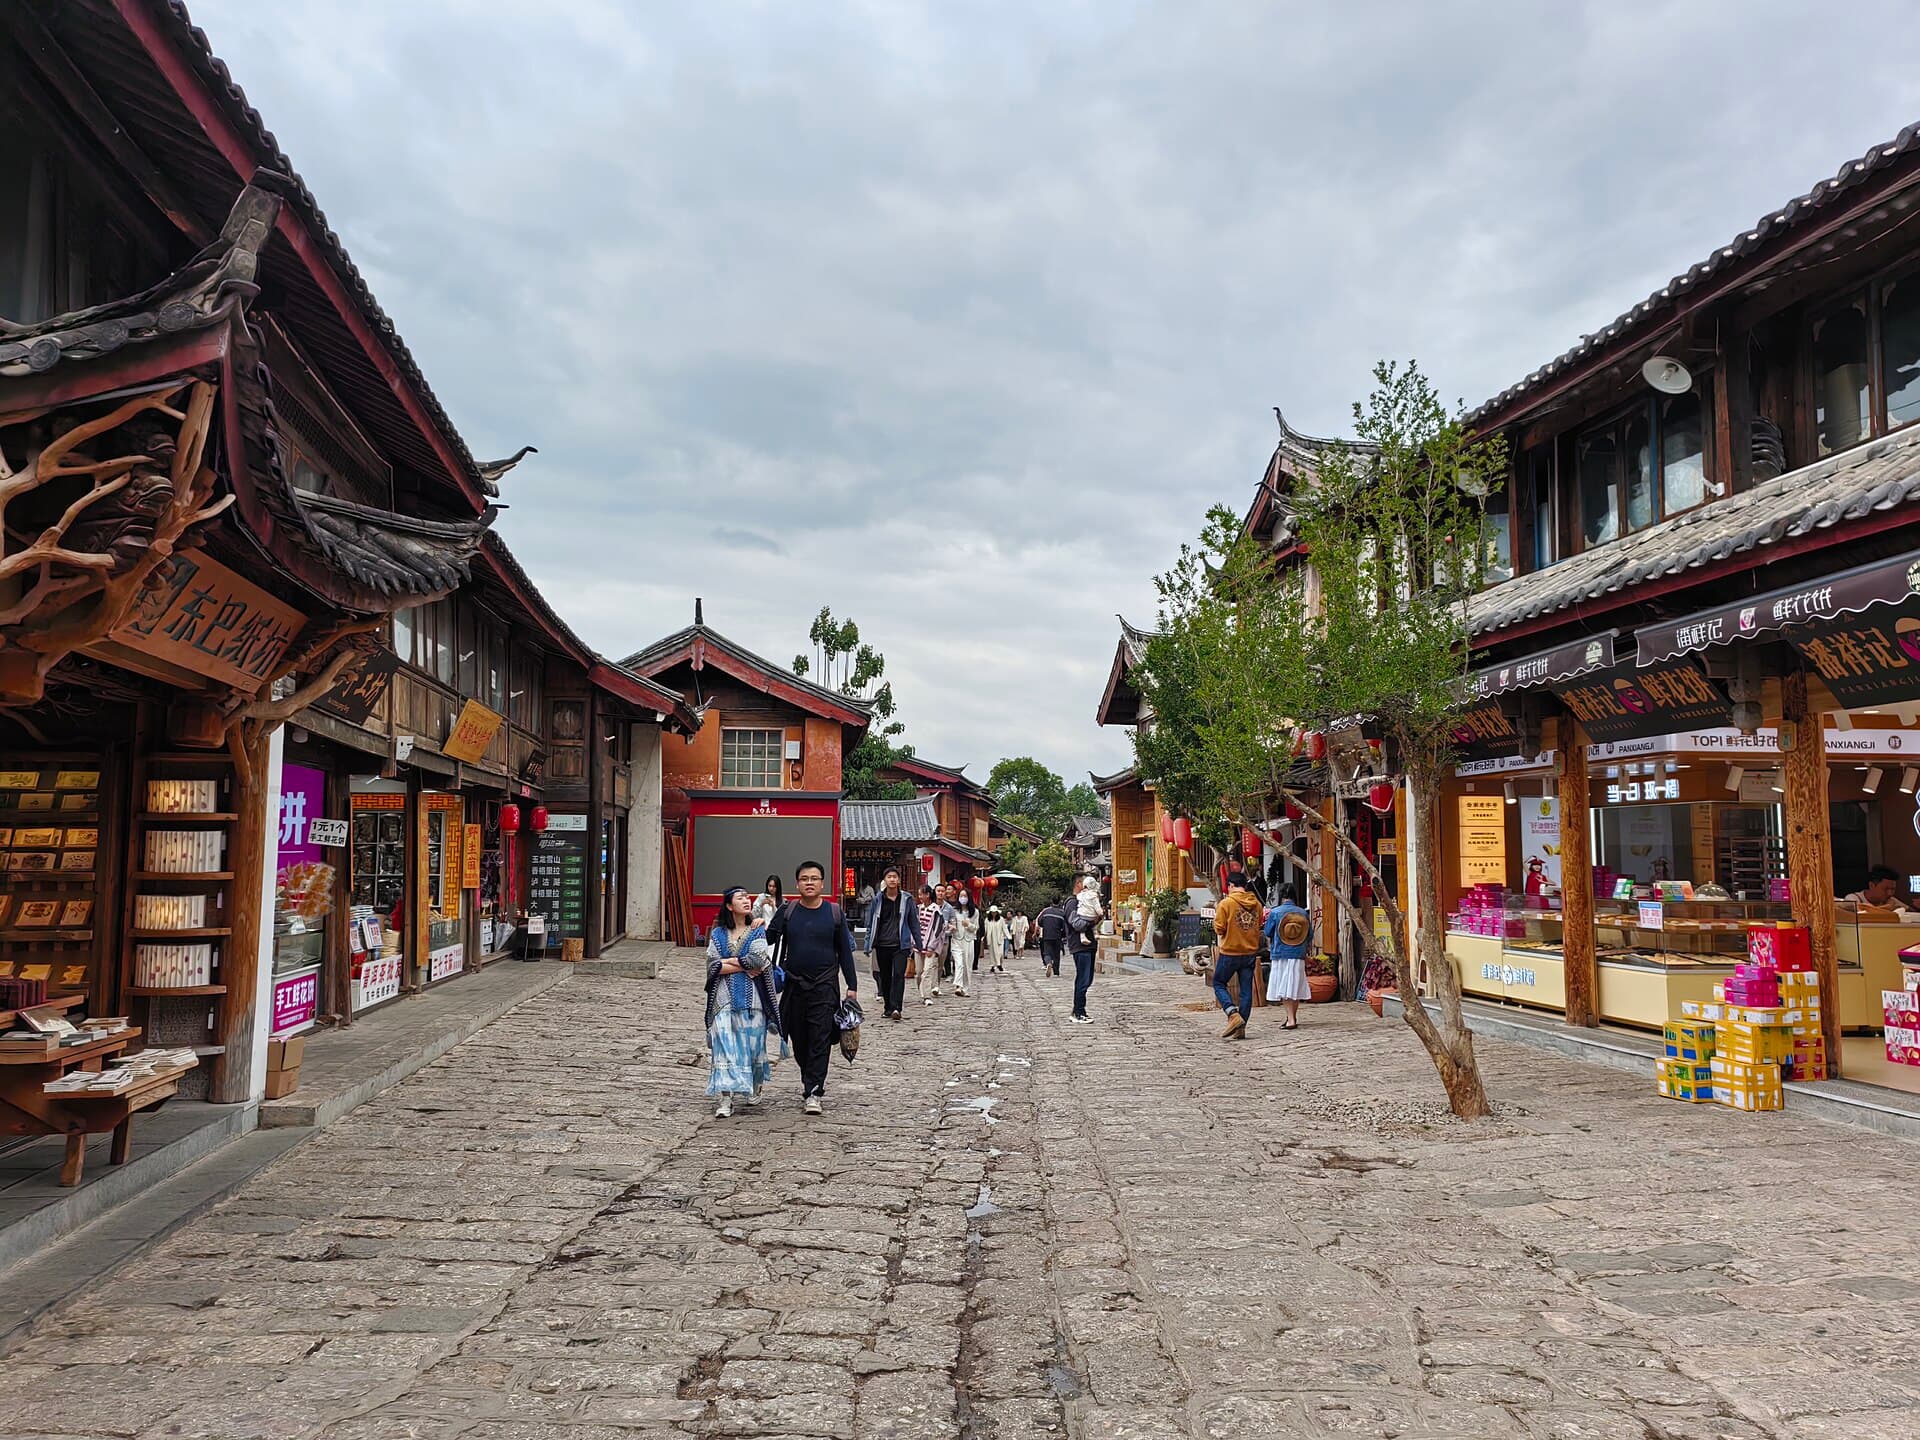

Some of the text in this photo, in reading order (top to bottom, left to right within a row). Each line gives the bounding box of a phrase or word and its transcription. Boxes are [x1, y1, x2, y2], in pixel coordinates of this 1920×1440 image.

[1676, 586, 1832, 648] 潘祥记 鲜花饼
[1799, 628, 1909, 679] 潘祥记
[1516, 657, 1549, 681] 鲜花饼
[1560, 666, 1717, 722] 潘祥记 鲜花饼
[1618, 742, 1655, 753] PANXIANGJI
[1691, 735, 1723, 747] TOPI
[1824, 741, 1876, 749] ANXIANGJI
[313, 821, 346, 833] 1元1个
[276, 979, 315, 1012] 手工鲜花饼
